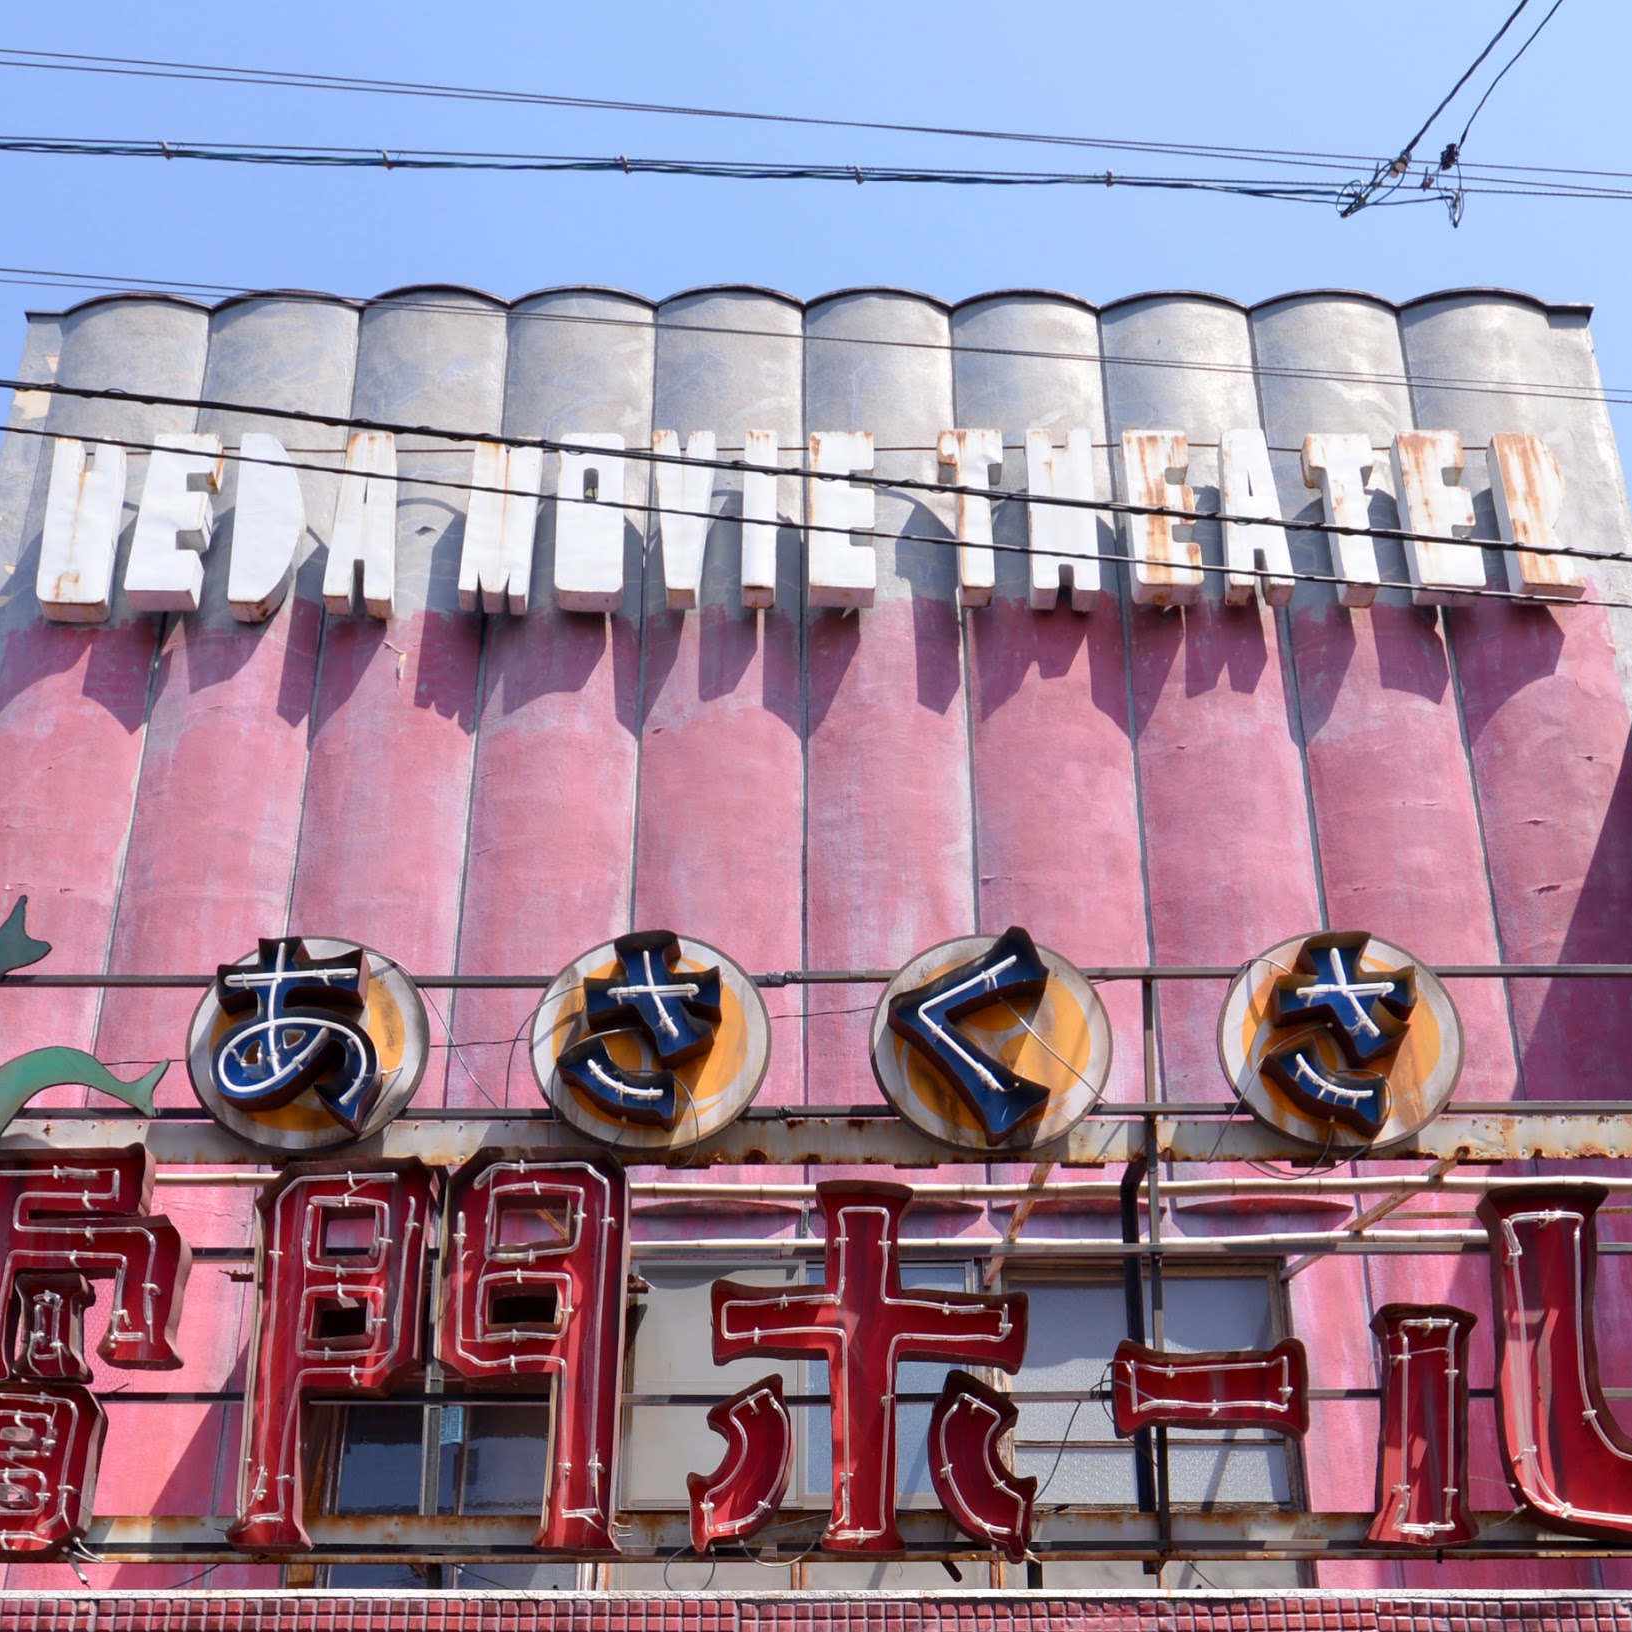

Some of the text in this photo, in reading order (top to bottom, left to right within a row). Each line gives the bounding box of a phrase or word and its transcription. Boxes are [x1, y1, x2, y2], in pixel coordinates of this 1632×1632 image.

[36, 428, 1589, 624] UEDA MOVIE THEATER
[212, 930, 1415, 1147] あさくさ
